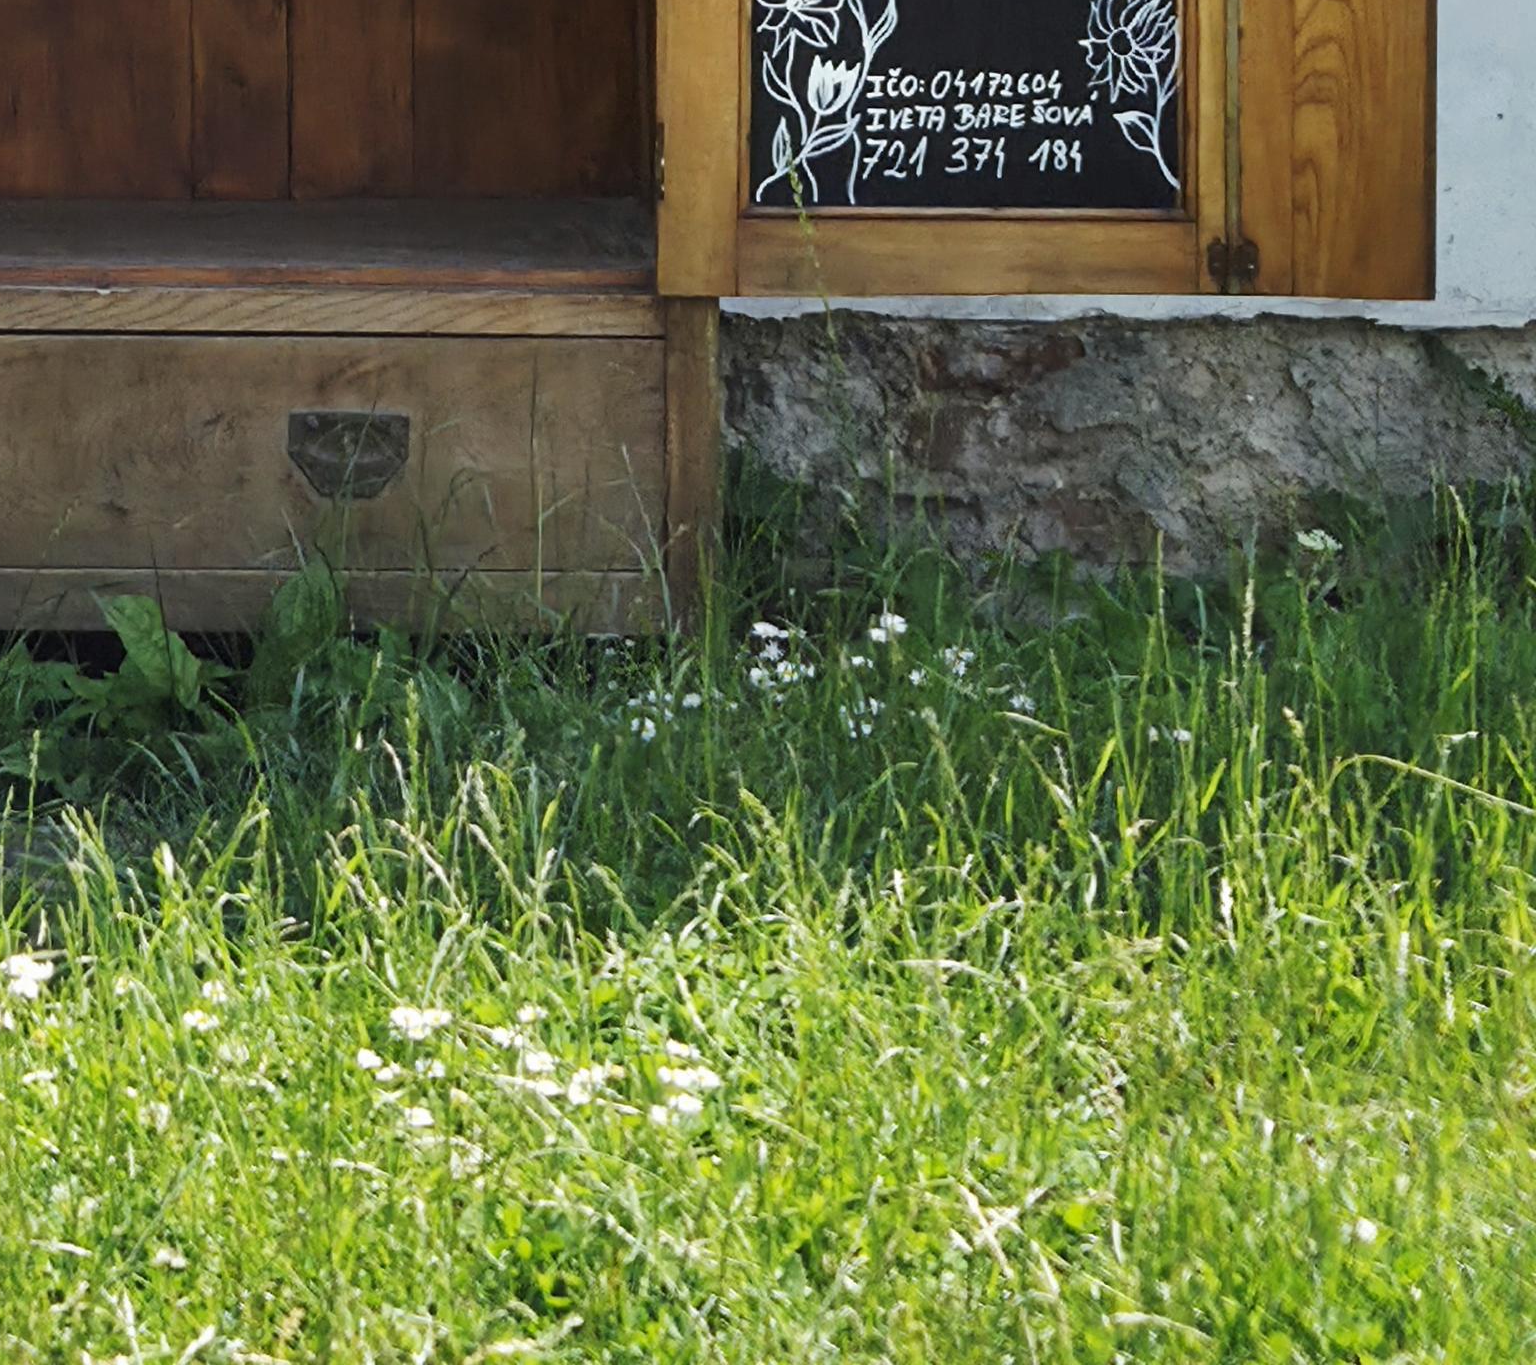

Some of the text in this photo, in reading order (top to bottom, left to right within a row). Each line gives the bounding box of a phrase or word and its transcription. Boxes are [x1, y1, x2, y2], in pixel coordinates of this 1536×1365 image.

[930, 69, 1063, 100] 04172604
[865, 104, 946, 133] IVETA
[862, 135, 1083, 180] 721 374 184
